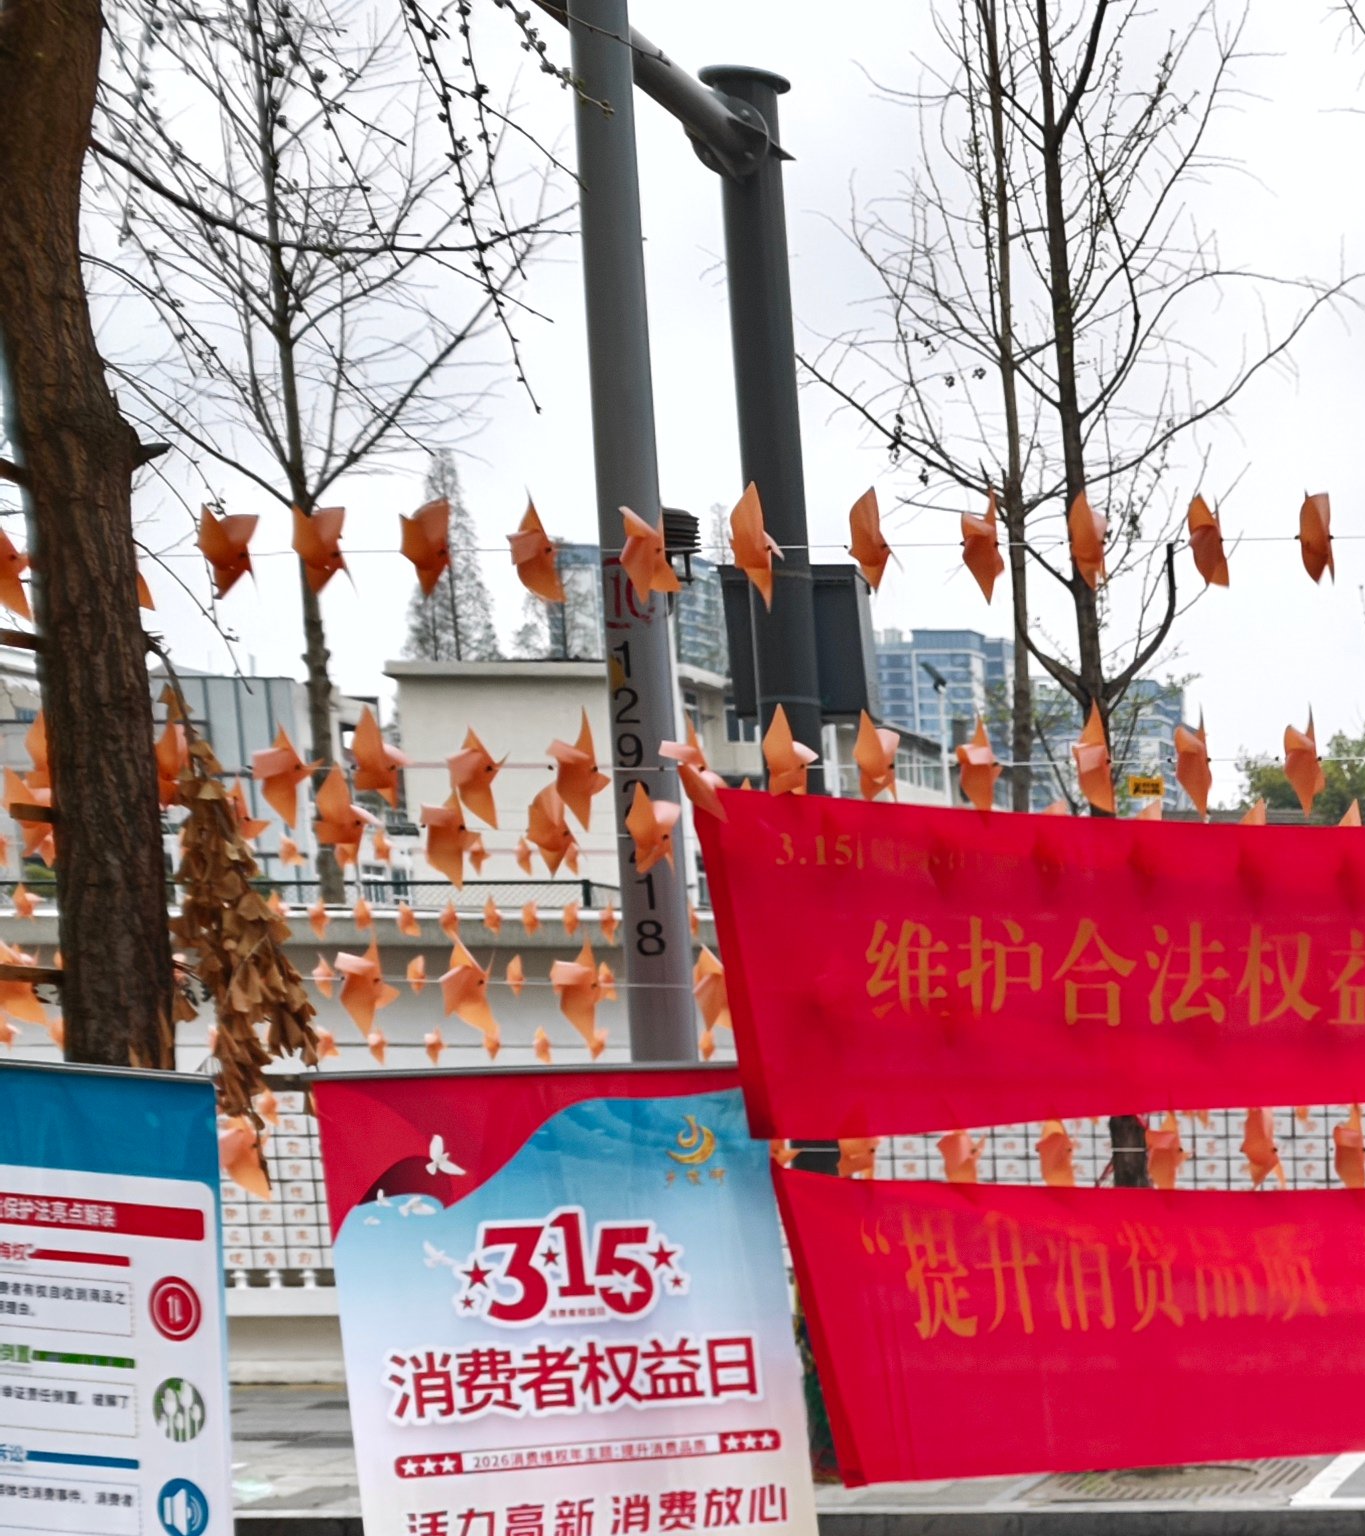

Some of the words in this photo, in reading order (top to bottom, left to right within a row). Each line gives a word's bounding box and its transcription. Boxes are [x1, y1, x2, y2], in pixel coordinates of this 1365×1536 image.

[0, 1196, 117, 1228] 保护法亮点解读
[483, 1212, 655, 1323] 315
[388, 1337, 758, 1419] 消费者权益日
[610, 1483, 789, 1536] 消费放心
